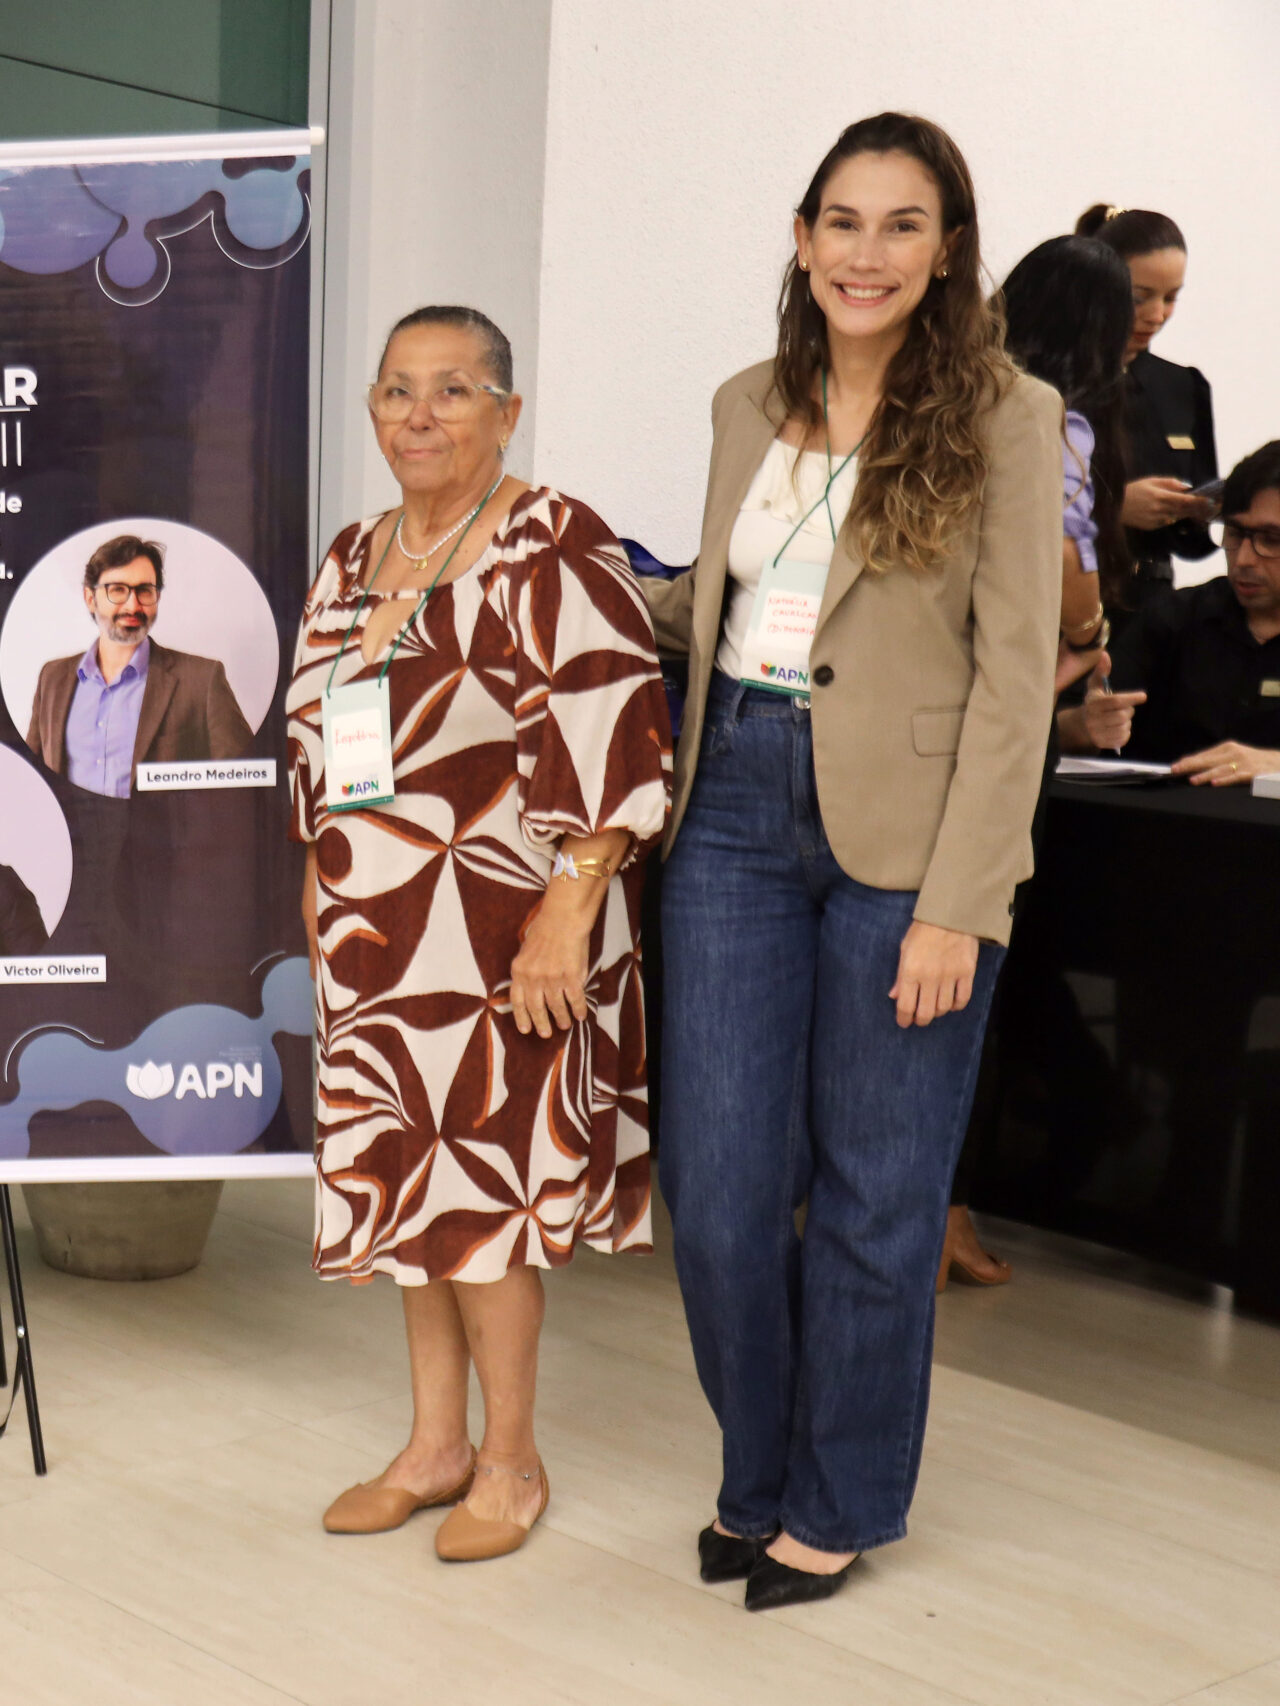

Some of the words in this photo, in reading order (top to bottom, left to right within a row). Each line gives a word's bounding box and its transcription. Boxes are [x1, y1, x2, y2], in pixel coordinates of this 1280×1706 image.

[776, 667, 809, 685] APN
[146, 769, 202, 783] Leandro
[206, 767, 268, 781] Medeiros
[355, 780, 379, 796] APN
[4, 964, 43, 978] Victor
[47, 963, 100, 977] Oliveira
[175, 1062, 263, 1100] APN
